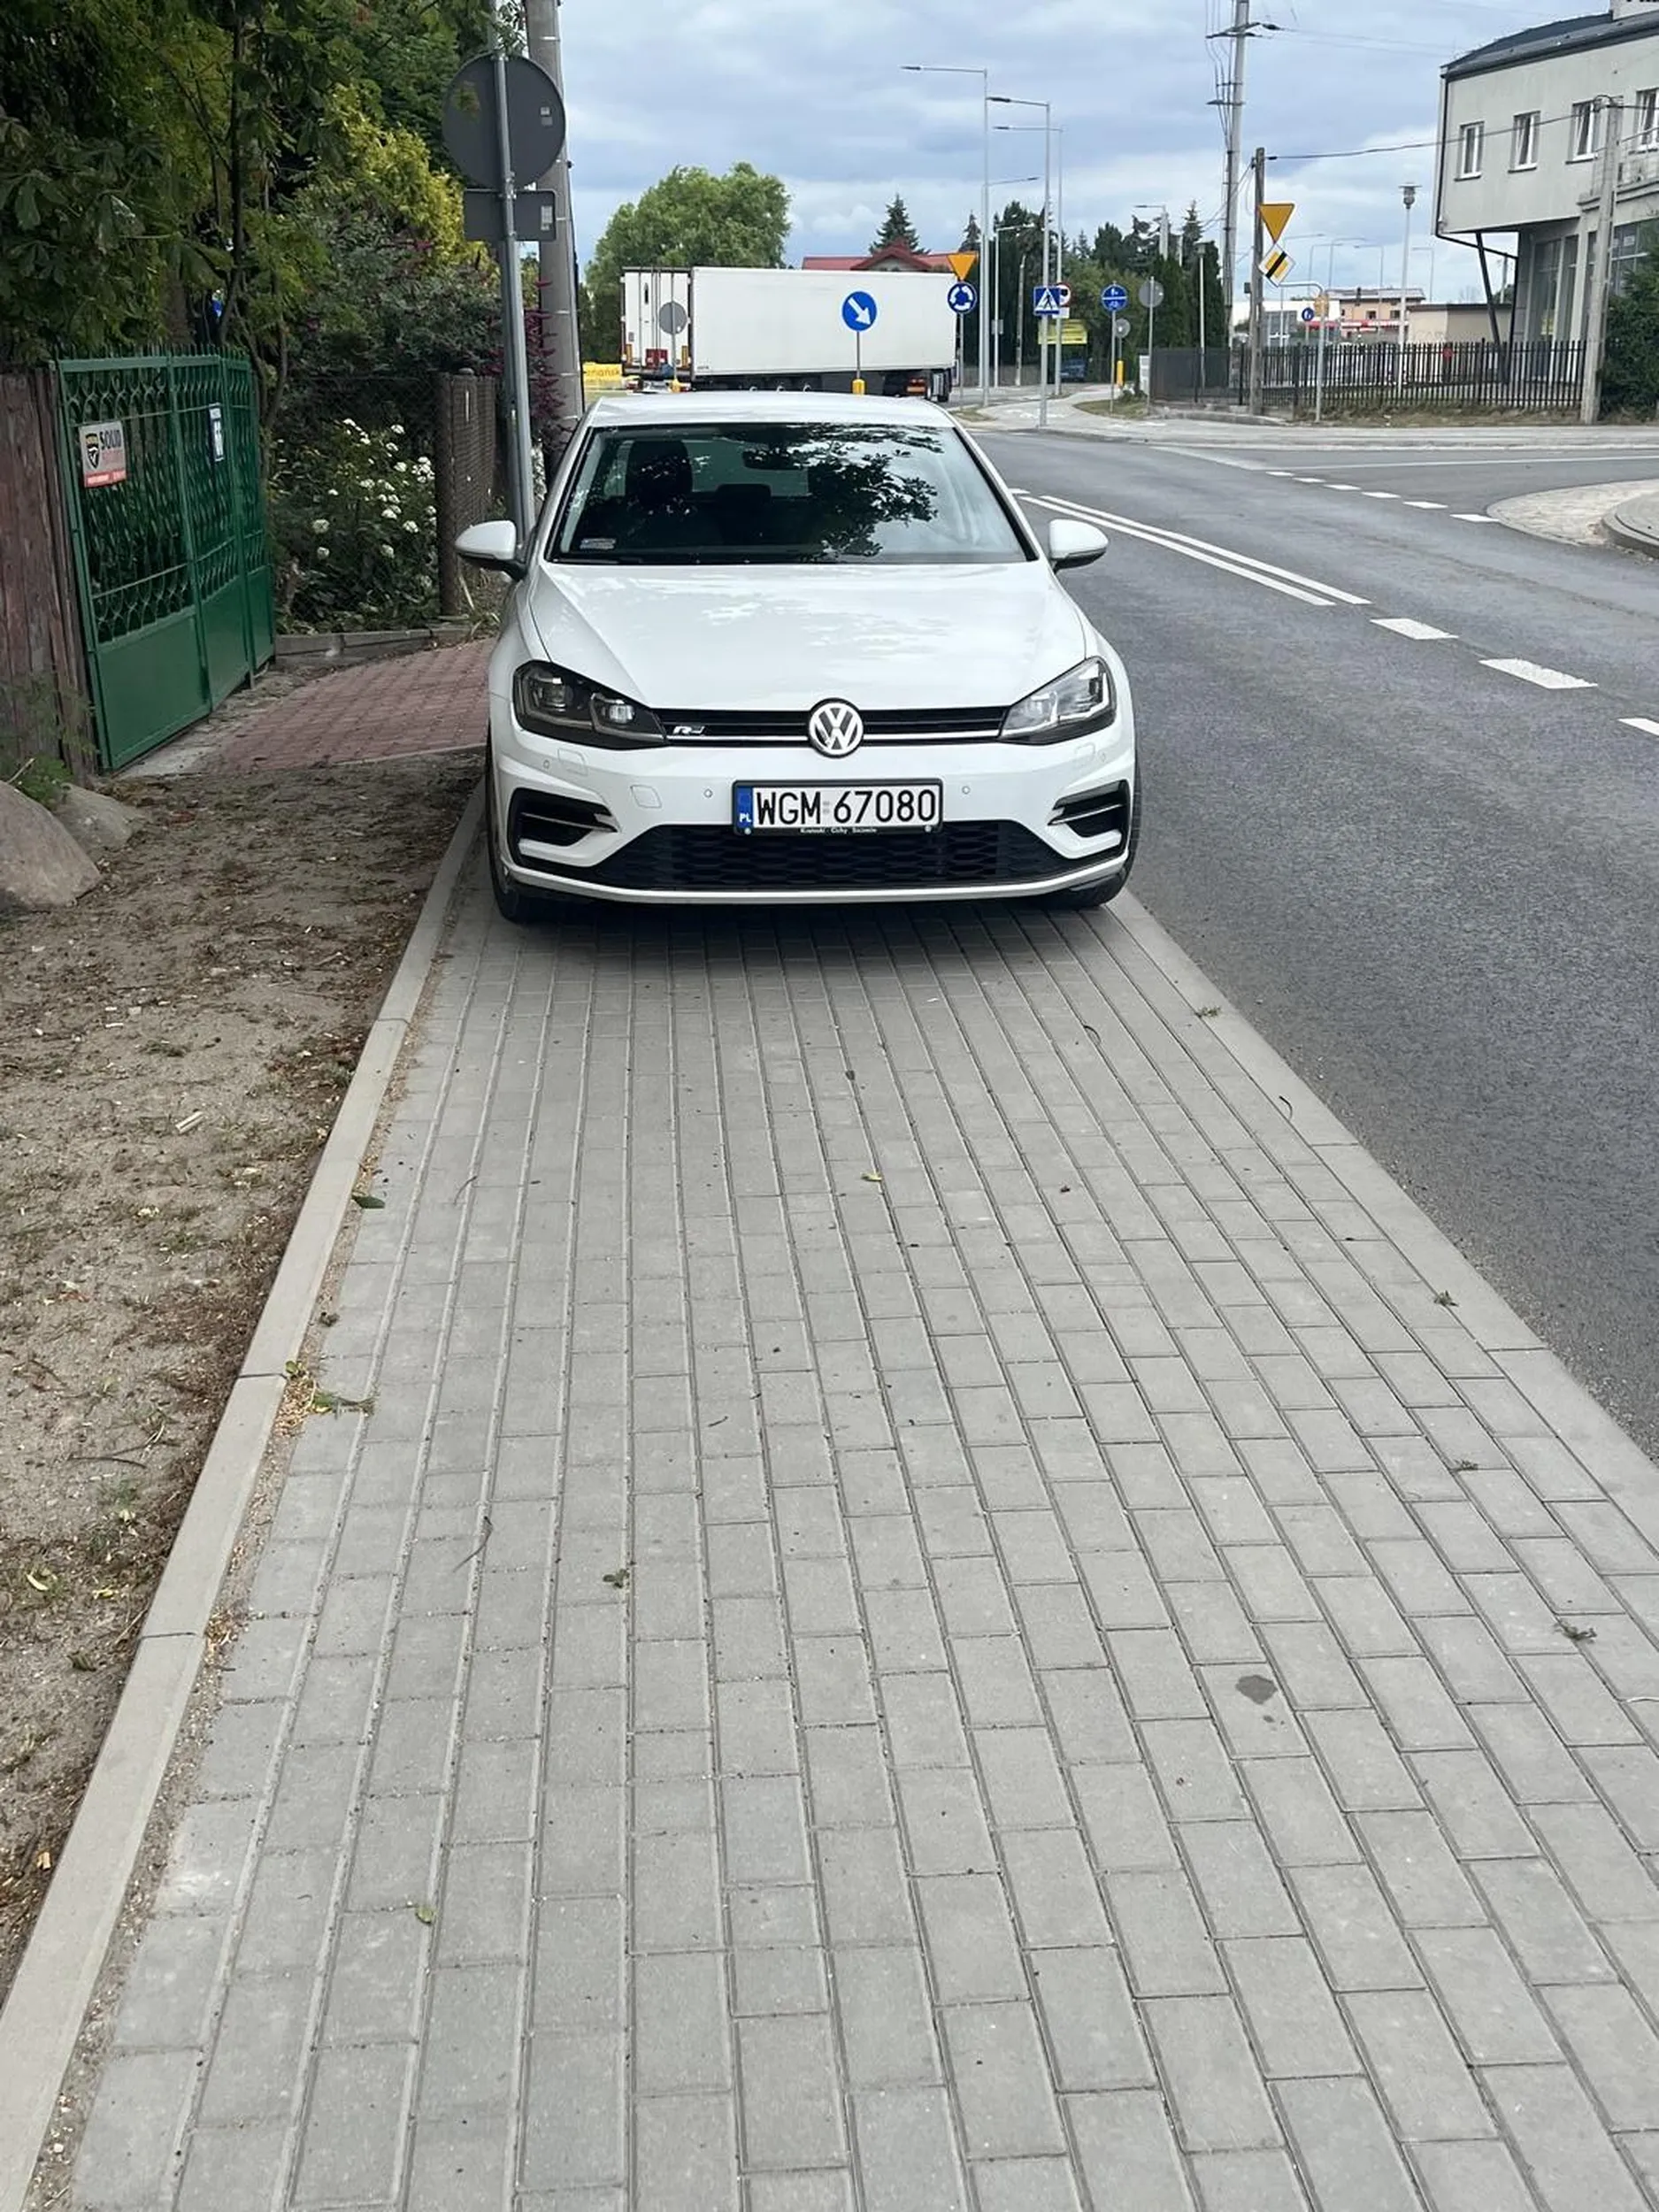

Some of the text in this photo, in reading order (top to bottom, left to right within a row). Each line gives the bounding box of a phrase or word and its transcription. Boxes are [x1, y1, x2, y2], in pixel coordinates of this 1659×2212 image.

[739, 812, 752, 823] PL
[757, 789, 936, 826] WGM 67080
